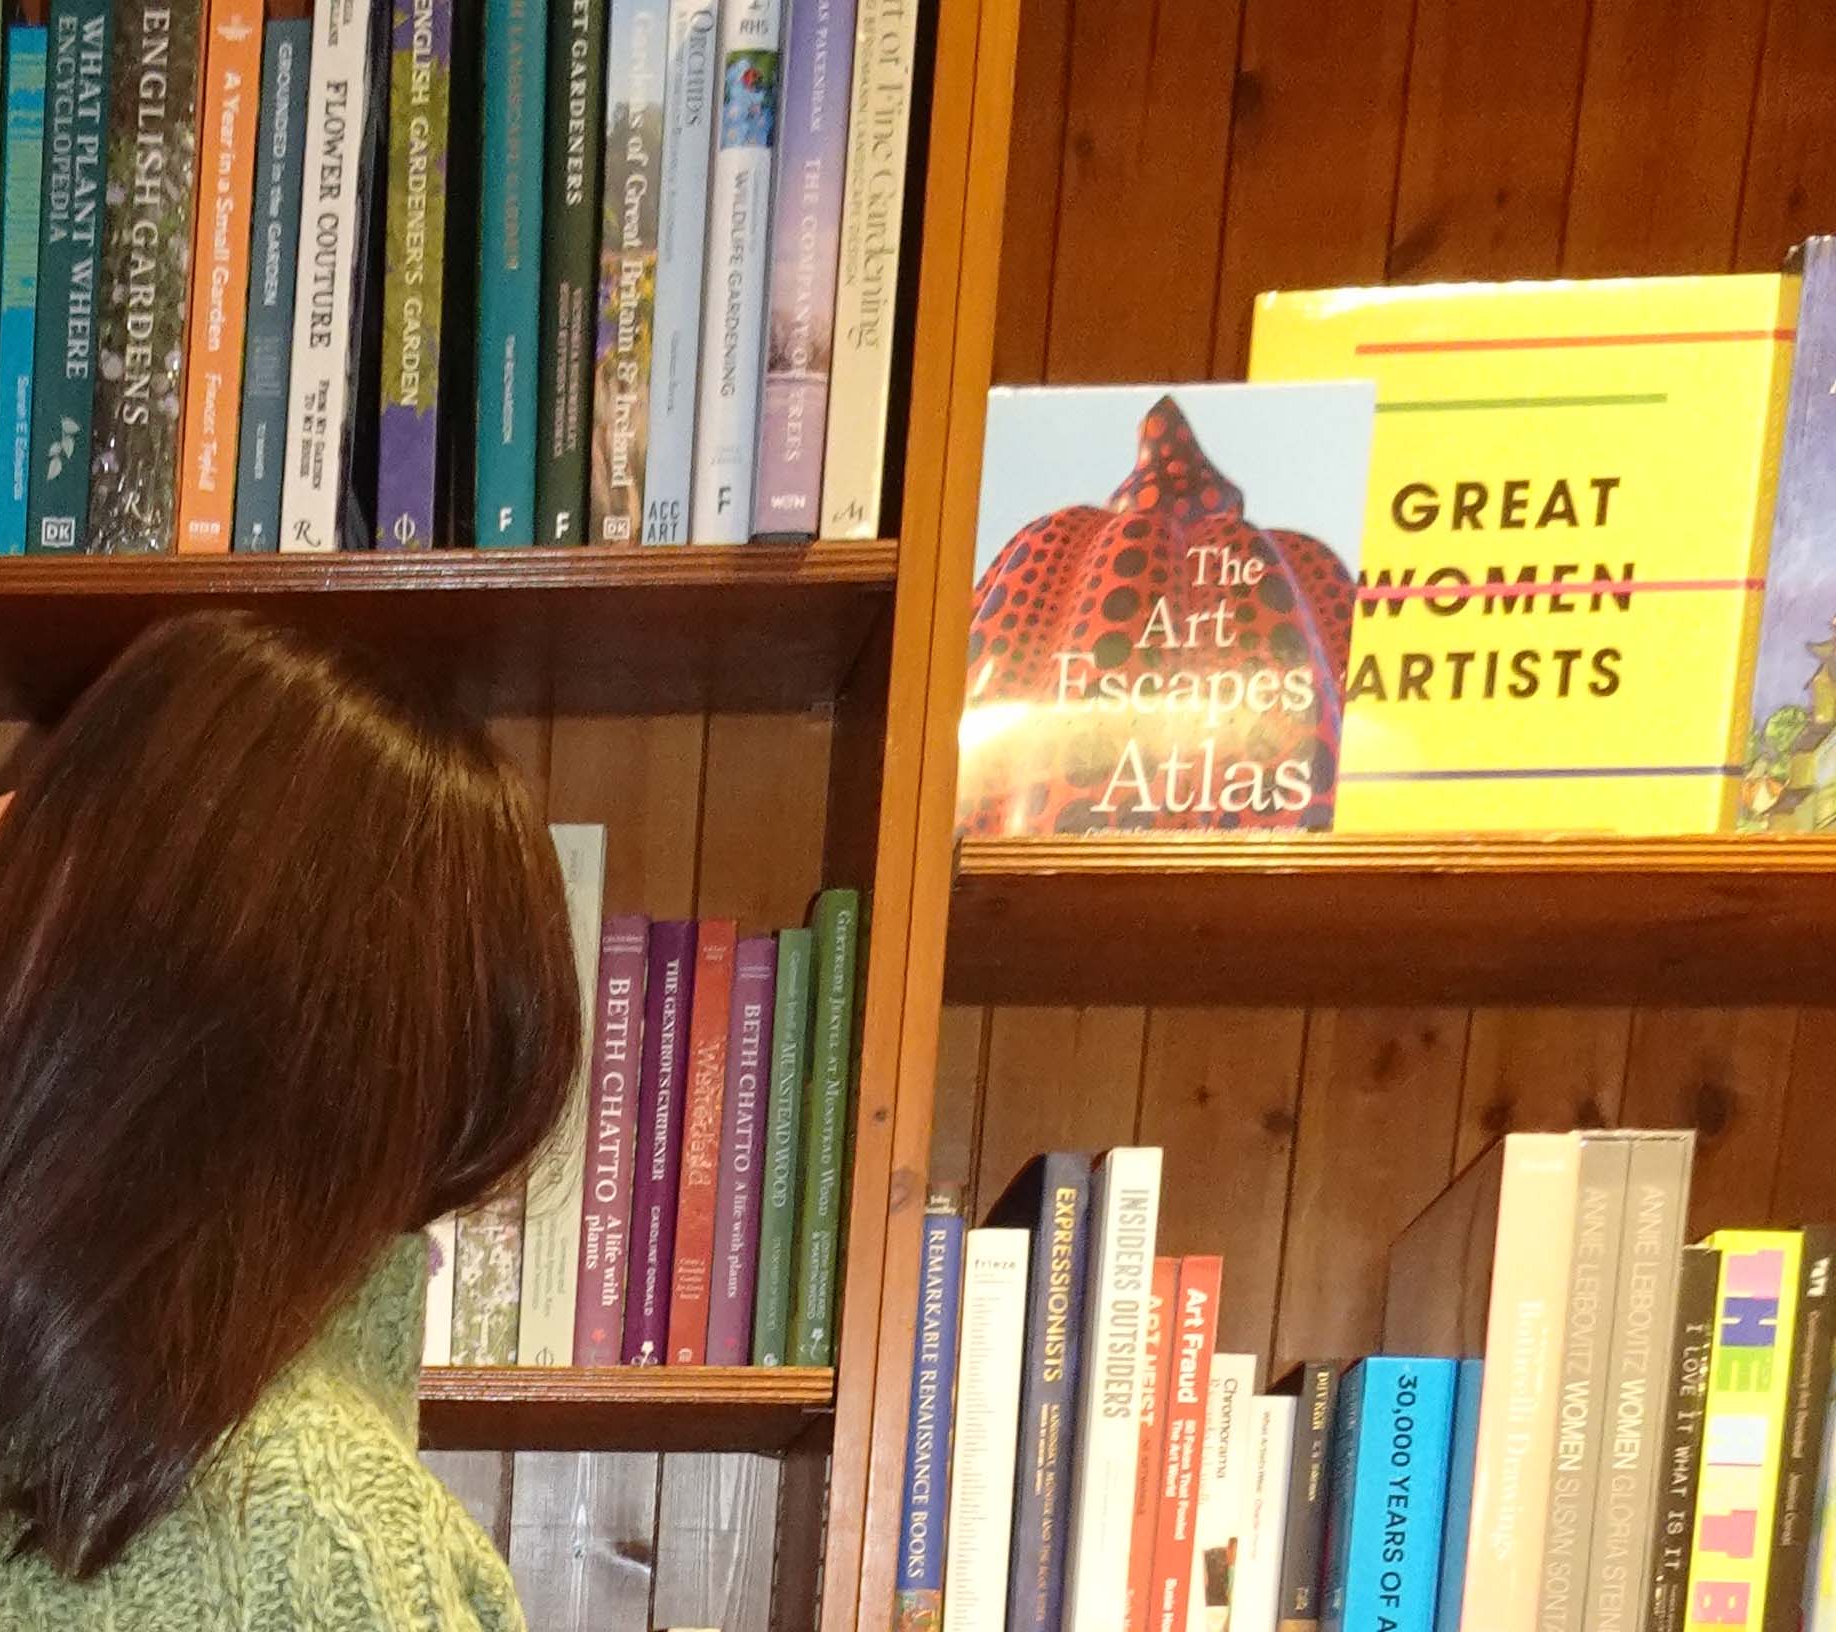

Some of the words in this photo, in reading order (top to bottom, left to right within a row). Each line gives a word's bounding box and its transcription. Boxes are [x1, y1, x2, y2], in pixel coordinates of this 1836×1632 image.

[78, 16, 105, 123] WHAT
[134, 7, 172, 206] ENGLISH
[626, 10, 651, 127] Gardens
[49, 16, 76, 244] ENCYCLOPEDIA
[319, 81, 348, 202] FLOWER
[625, 135, 648, 166] of
[72, 134, 99, 246] PLANT
[622, 173, 647, 247] Great
[65, 259, 93, 379] WHERE
[122, 219, 158, 424] GARDENS
[309, 213, 338, 349] COUTURE
[618, 259, 645, 351] Britain
[617, 361, 638, 388] &
[610, 393, 637, 488] Ireland
[1389, 478, 1621, 532] GREAT
[1188, 547, 1265, 586] The
[1359, 563, 1634, 617] WOMEN
[1139, 598, 1236, 648] Art
[1052, 652, 1314, 725] Escapes
[1346, 650, 1624, 704] ARTISTS
[1090, 738, 1312, 812] Atlas
[604, 977, 631, 1060] BETH
[595, 1072, 625, 1202] CHATTO
[1041, 1187, 1078, 1383] EXPRESSIONISTS
[1112, 1187, 1152, 1291] INSIDERS
[919, 1229, 947, 1363] REMARKABLE
[1184, 1287, 1207, 1328] Art
[1101, 1300, 1141, 1419] OUTSIDERS
[1176, 1333, 1204, 1404] Fraud
[911, 1368, 940, 1504] RENAISSANCE
[1389, 1375, 1417, 1468] 30,000
[906, 1510, 930, 1579] BOOKS
[1381, 1475, 1411, 1563] YEARS
[1379, 1571, 1402, 1607] OF
